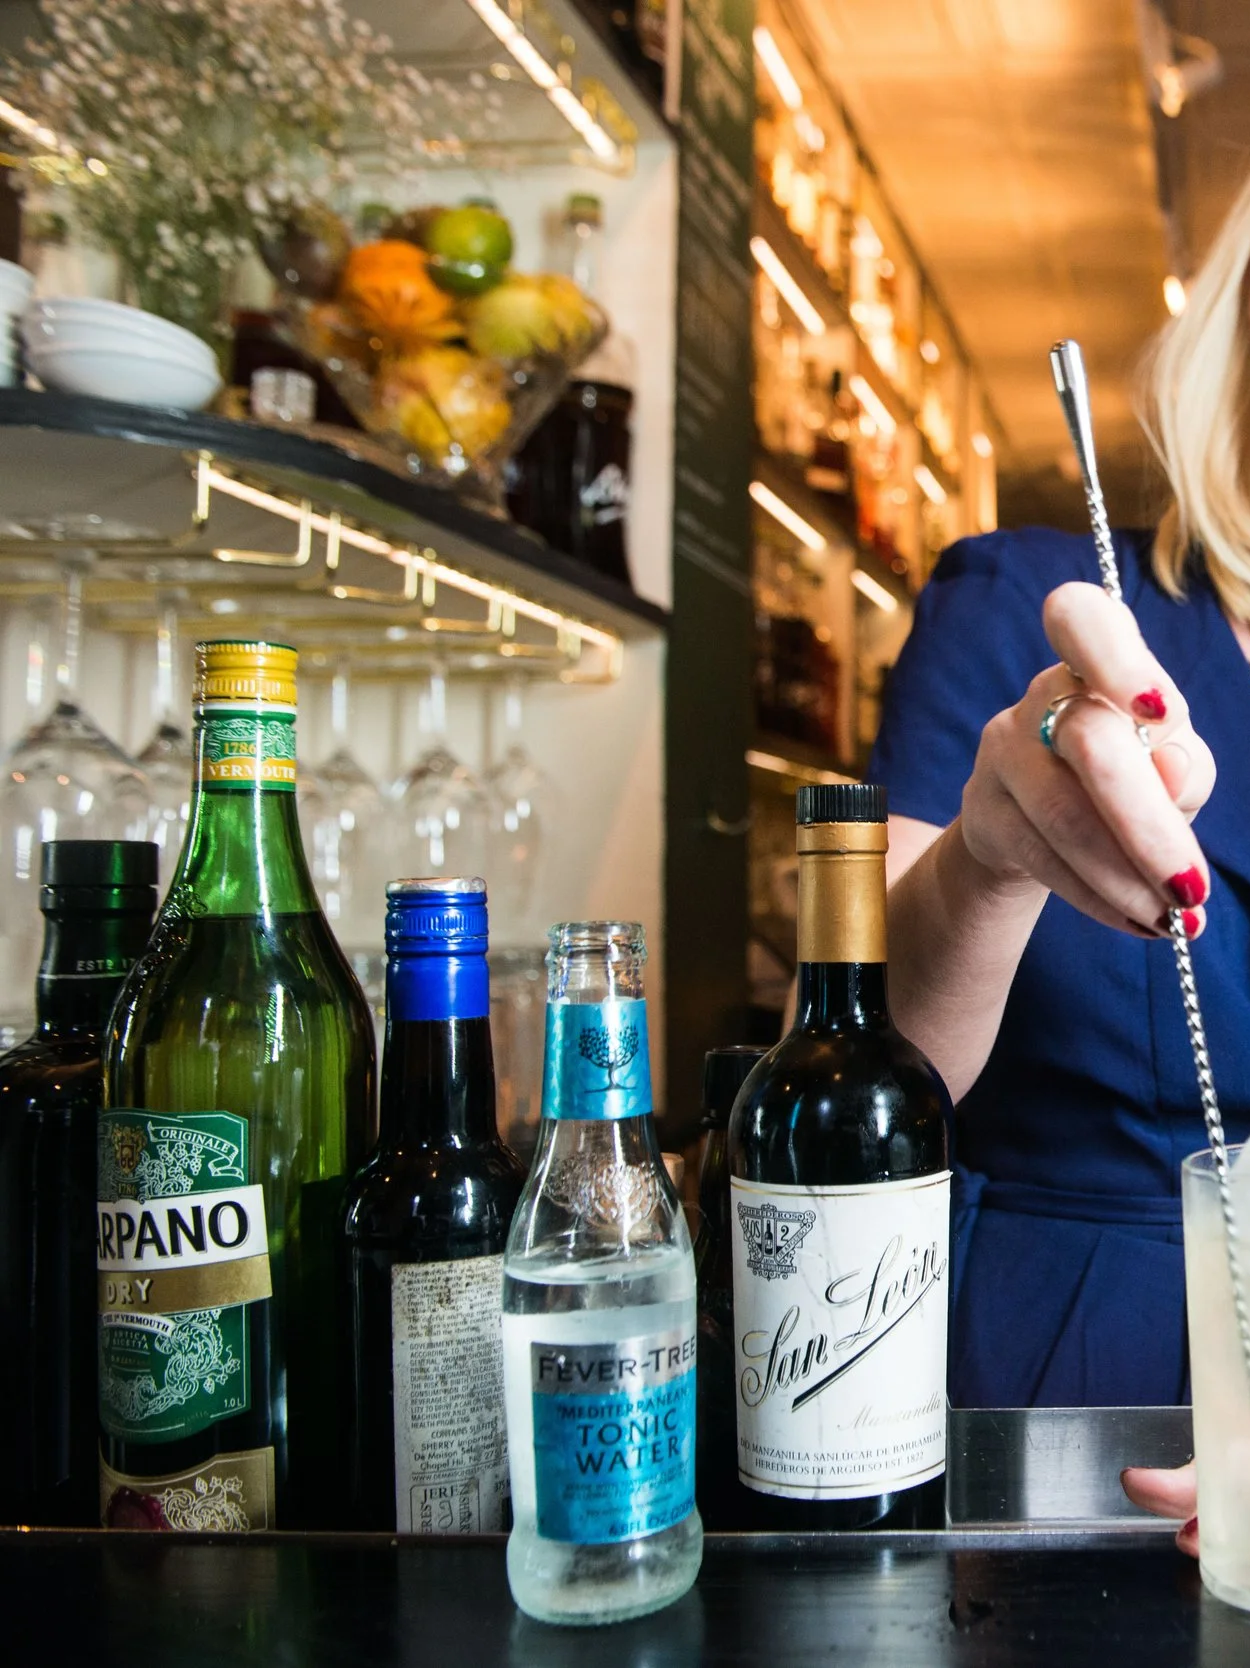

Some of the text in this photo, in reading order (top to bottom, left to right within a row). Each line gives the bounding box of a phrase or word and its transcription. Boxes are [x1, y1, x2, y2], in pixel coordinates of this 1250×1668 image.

[223, 741, 256, 755] 1786
[160, 1128, 231, 1154] ORIGINALE
[97, 1200, 251, 1260] RPANO
[106, 1278, 152, 1305] DRY
[120, 1314, 170, 1333] VERMOUTH
[741, 1233, 947, 1408] San León
[538, 1335, 696, 1383] FEVER-TREE
[836, 1391, 942, 1432] Manzanilla
[575, 1408, 678, 1448] TONIC
[414, 1451, 426, 1462] De
[427, 1447, 459, 1460] Maison
[421, 1440, 455, 1452] SHERRY
[575, 1436, 681, 1476] WATER
[752, 1443, 811, 1462] MANZANILLA
[813, 1447, 873, 1462] SANLÚCAR
[876, 1448, 889, 1458] DE
[892, 1429, 943, 1454] BARRAMEDA
[420, 1459, 450, 1472] Chapel
[755, 1457, 810, 1475] HEREDEROS
[812, 1464, 827, 1476] DE
[906, 1451, 925, 1466] 1822
